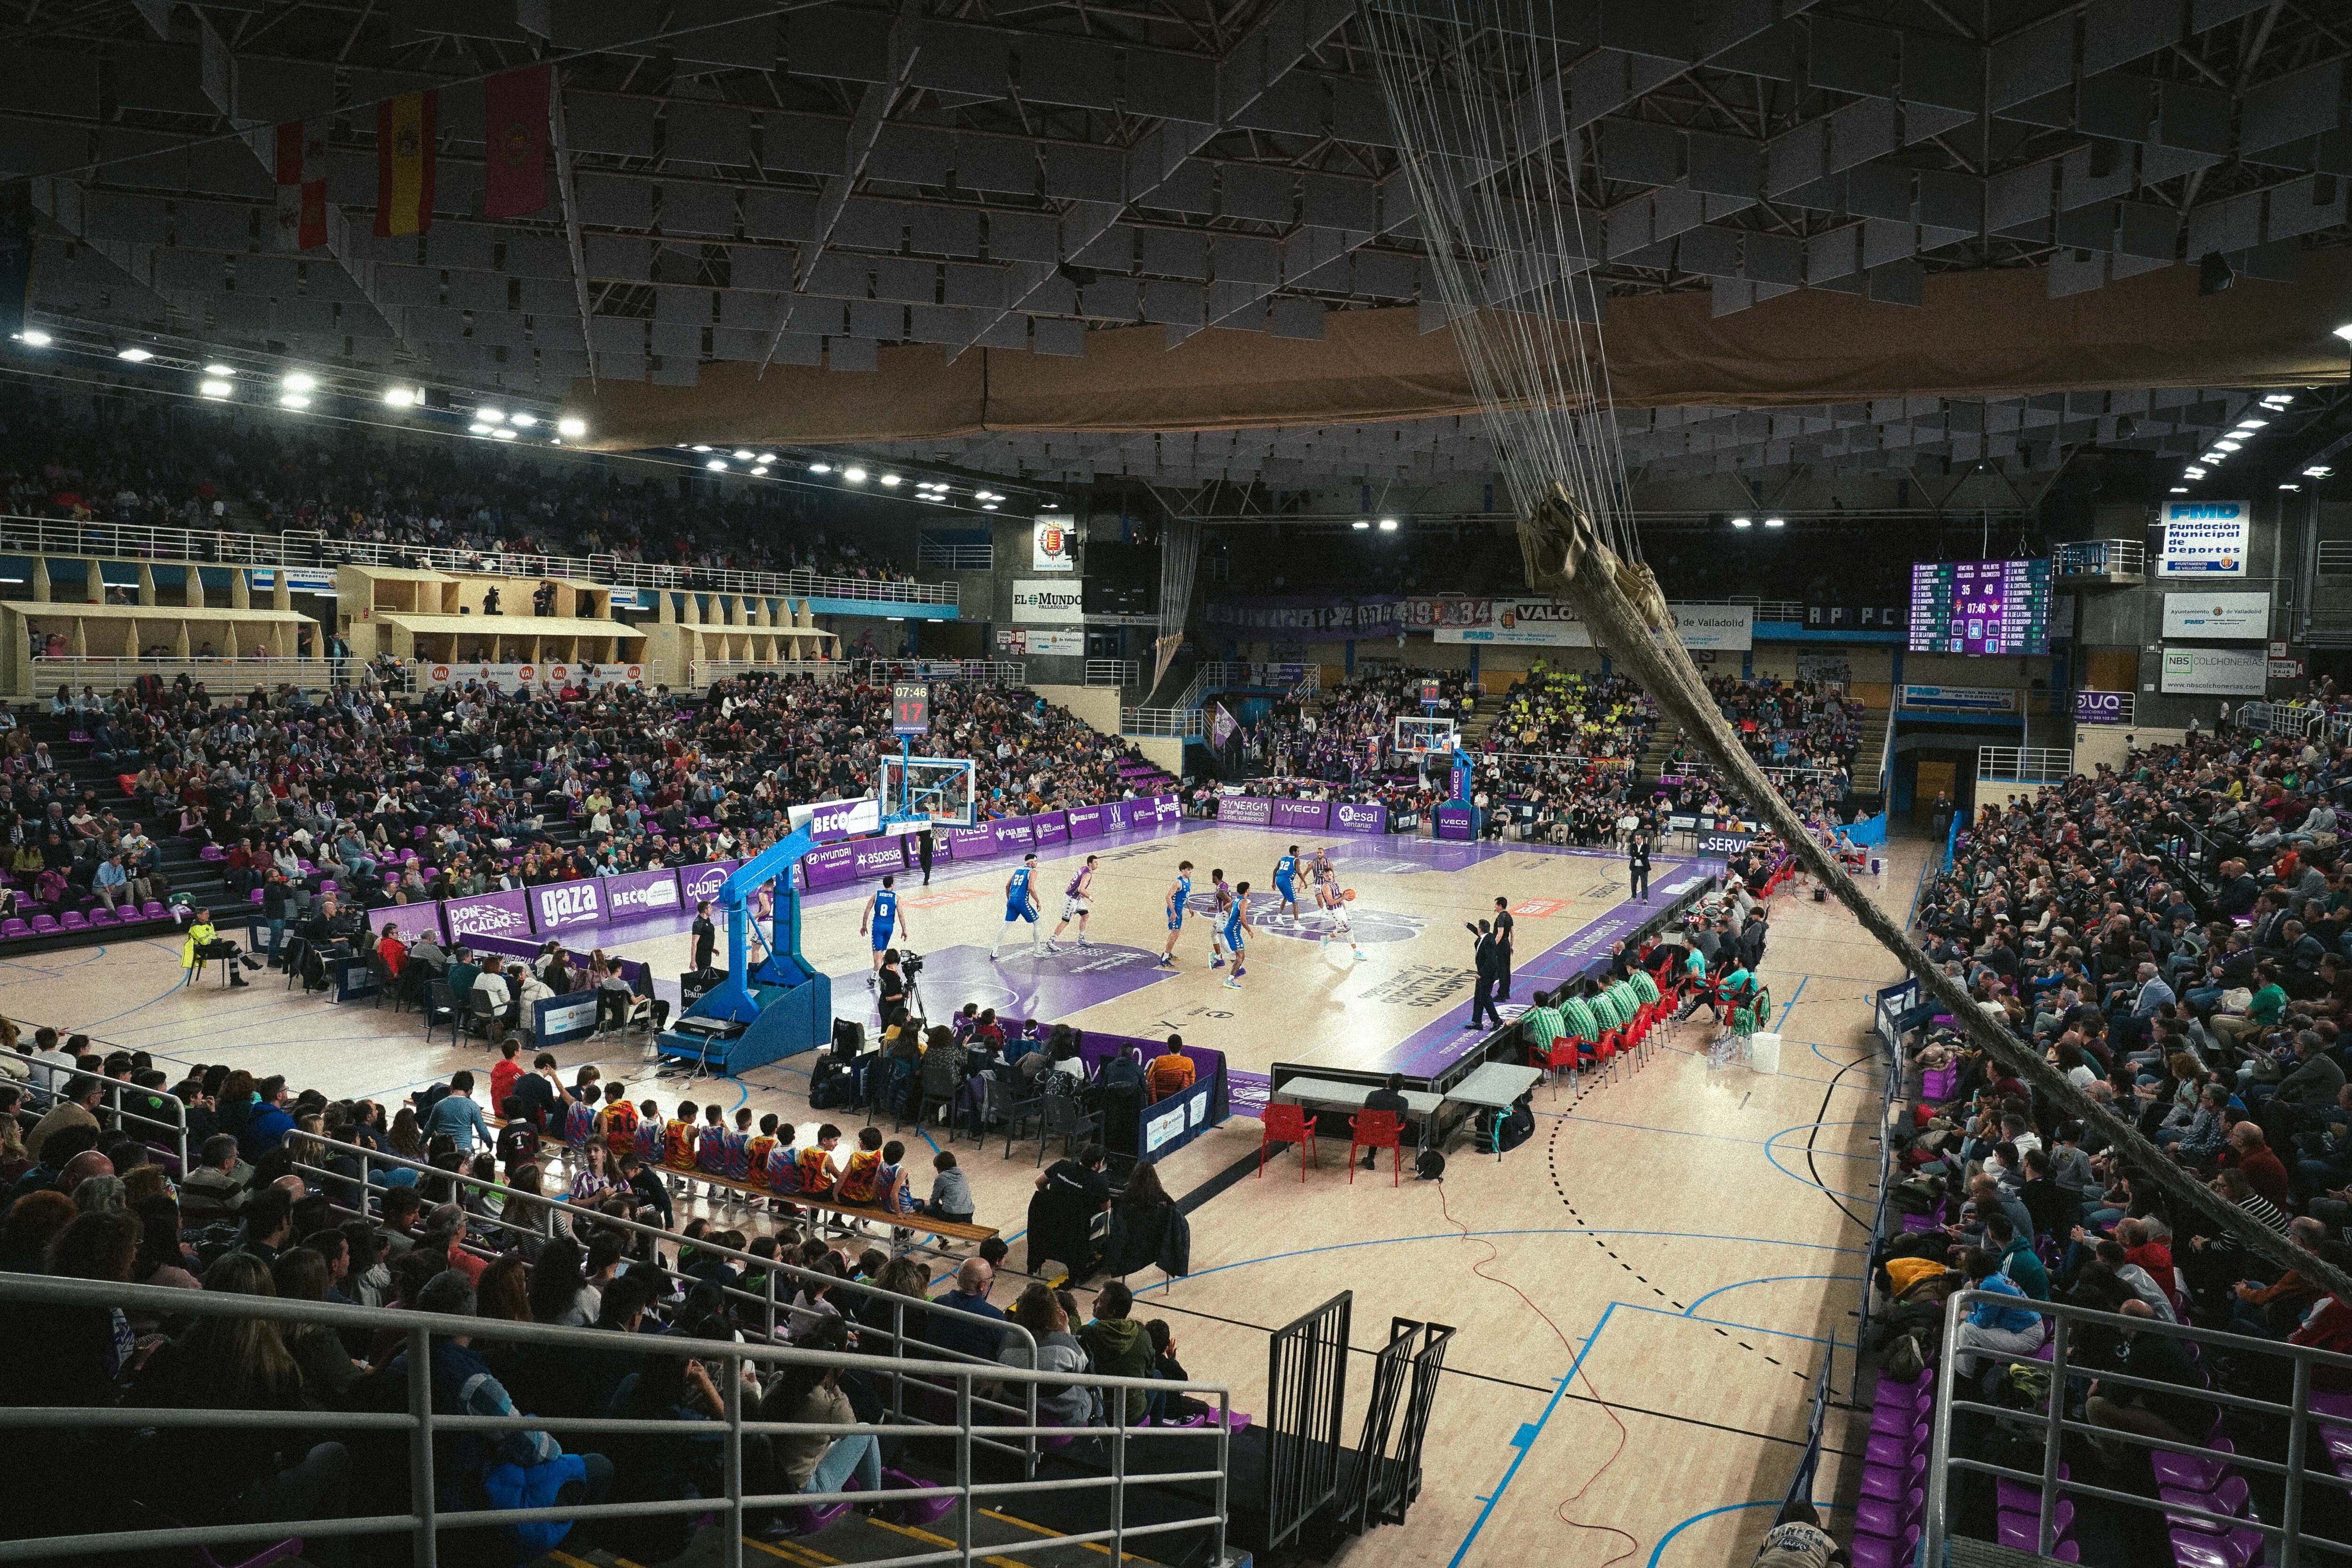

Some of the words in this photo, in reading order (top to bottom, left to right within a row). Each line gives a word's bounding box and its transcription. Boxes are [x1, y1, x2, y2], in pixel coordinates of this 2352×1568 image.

[2170, 504, 2240, 520] FMD
[1962, 585, 1970, 595] 35
[1984, 584, 1993, 594] 49
[1014, 595, 1027, 604] EL
[1039, 593, 1081, 605] MUNDO
[1968, 603, 1986, 613] 07:46
[1698, 618, 1744, 627] Valladolid
[1462, 631, 1495, 640] FMD
[2296, 664, 2303, 674] A
[896, 687, 927, 697] 07:46
[1423, 687, 1438, 698] 17
[899, 702, 924, 722] 17
[1156, 802, 1180, 814] HORSE
[1281, 804, 1320, 814] IVECO
[813, 811, 849, 833] BECO
[1110, 821, 1126, 830] envaser
[1043, 824, 1065, 833] VALLADOLID
[820, 847, 851, 861] HYUNDAI
[868, 847, 901, 864] aspasia
[1279, 860, 1289, 871] 32
[1013, 874, 1024, 886] 22
[613, 889, 647, 907] BECO
[541, 885, 598, 927] gaza
[880, 903, 888, 917] 8
[450, 905, 480, 921] DON
[453, 915, 511, 936] BACALAO
[1381, 974, 1452, 1004] VALLADOLID
[1407, 969, 1478, 1007] ALIMENTOS
